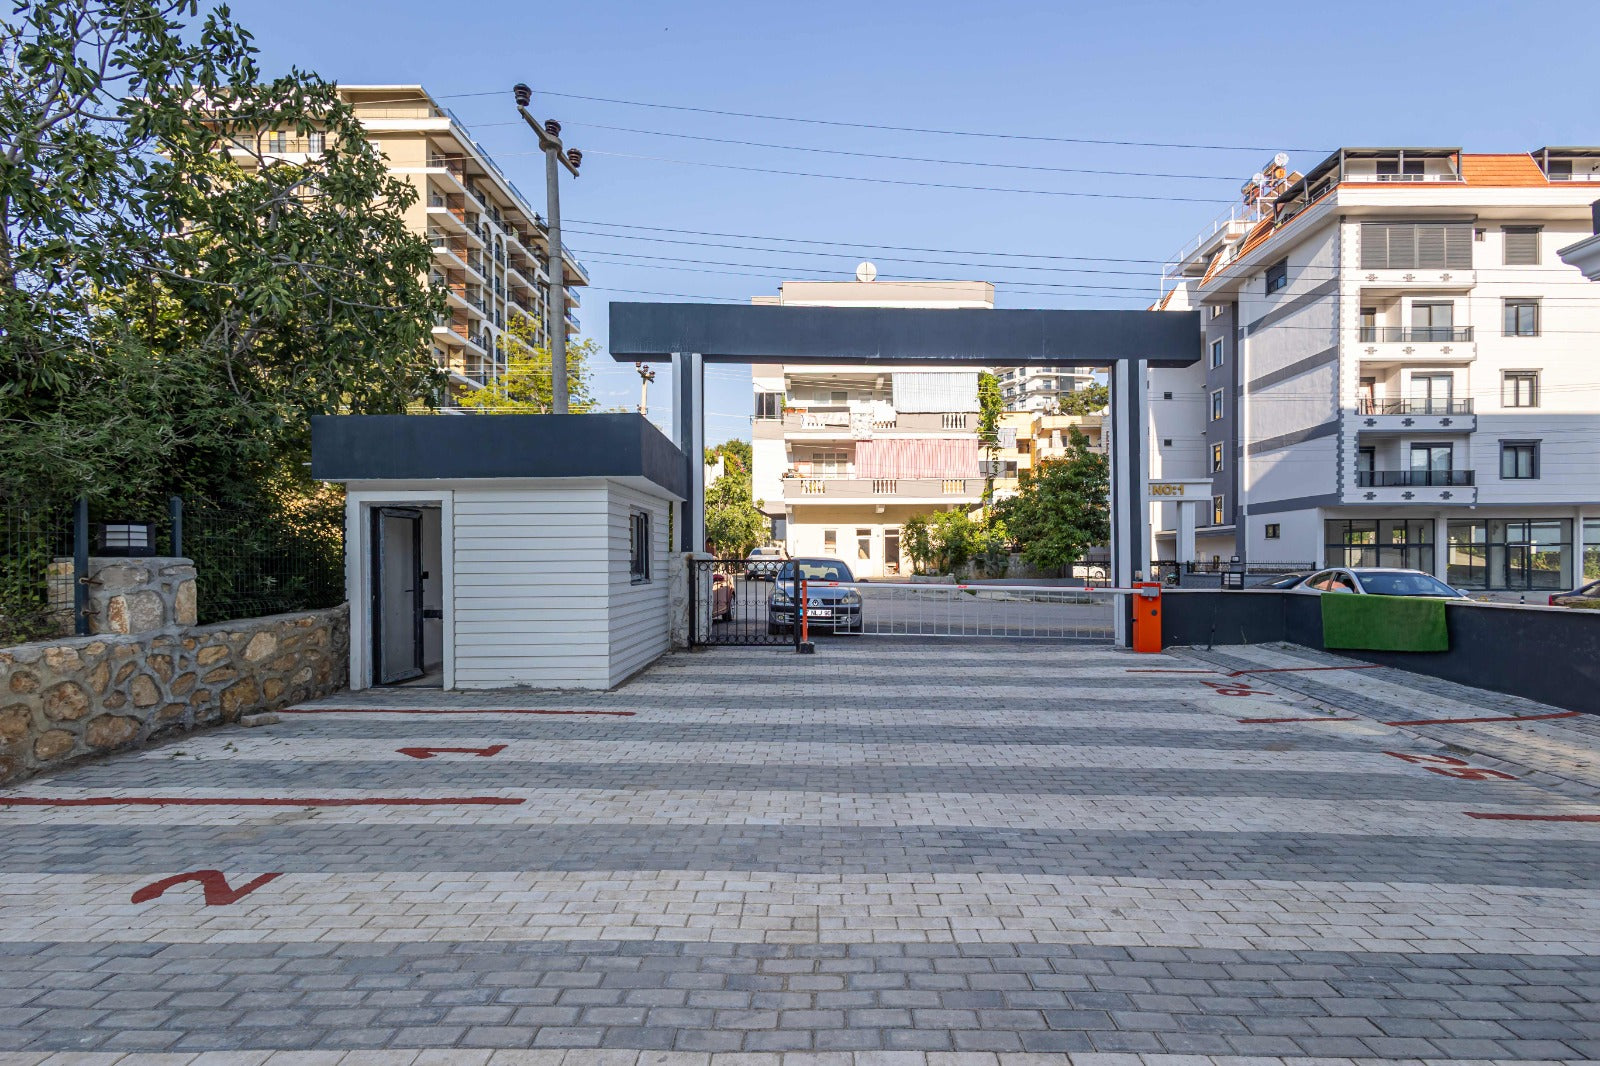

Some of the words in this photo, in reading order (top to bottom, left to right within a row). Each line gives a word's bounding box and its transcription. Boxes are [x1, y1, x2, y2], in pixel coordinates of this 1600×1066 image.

[1152, 484, 1185, 496] NO:1
[394, 744, 509, 760] 1
[1380, 750, 1519, 781] 25
[130, 869, 285, 906] 2
